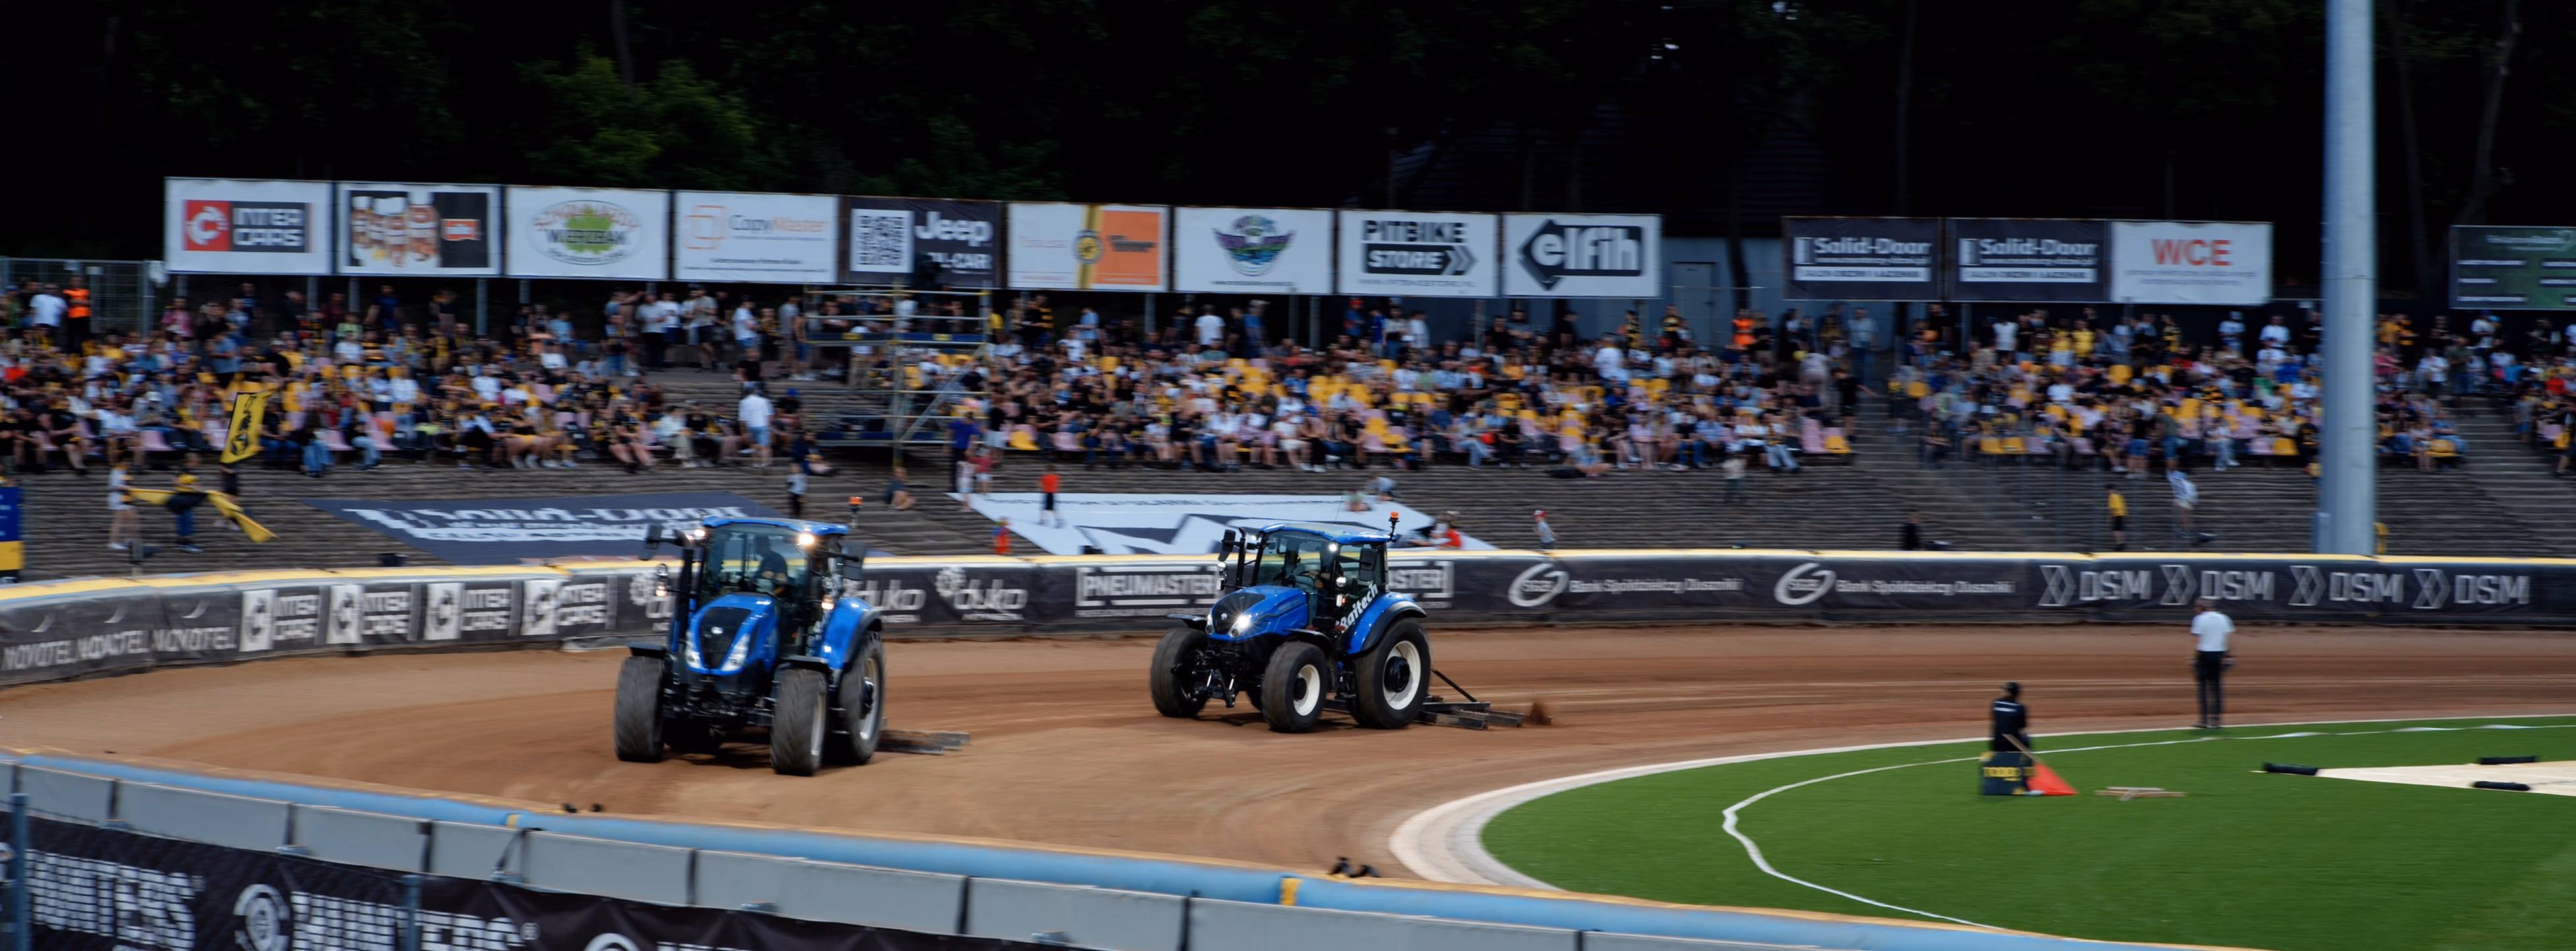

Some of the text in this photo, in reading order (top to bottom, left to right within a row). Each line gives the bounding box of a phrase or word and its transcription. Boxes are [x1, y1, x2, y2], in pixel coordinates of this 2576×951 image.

[233, 208, 304, 226] INTER
[233, 229, 304, 246] CARS
[915, 211, 994, 247] Jeep
[1362, 221, 1468, 243] PITBIKE
[1814, 237, 1933, 254] Solid-Door
[1979, 238, 2098, 255] Solid-Door
[2150, 239, 2233, 265] WCE
[1368, 250, 1445, 268] STORE
[558, 584, 607, 604] INTER
[954, 579, 1029, 609] duko
[1083, 574, 1213, 596] PNEUMASTER
[1569, 580, 1604, 592] Bank
[1836, 580, 1871, 592] Bank
[2080, 570, 2152, 601] DSM
[2201, 570, 2275, 600] DSM
[2329, 572, 2404, 602] DSM
[2455, 575, 2530, 604] DSM
[275, 595, 318, 616] INTER
[363, 592, 410, 612] INTER
[463, 589, 510, 608] INTER
[273, 618, 318, 640] CARS
[361, 614, 409, 635] CARS
[461, 611, 510, 631] CARS
[77, 630, 149, 660] NOVOTEL
[151, 627, 238, 651] NOVOTEL
[24, 849, 195, 951] UNTERS
